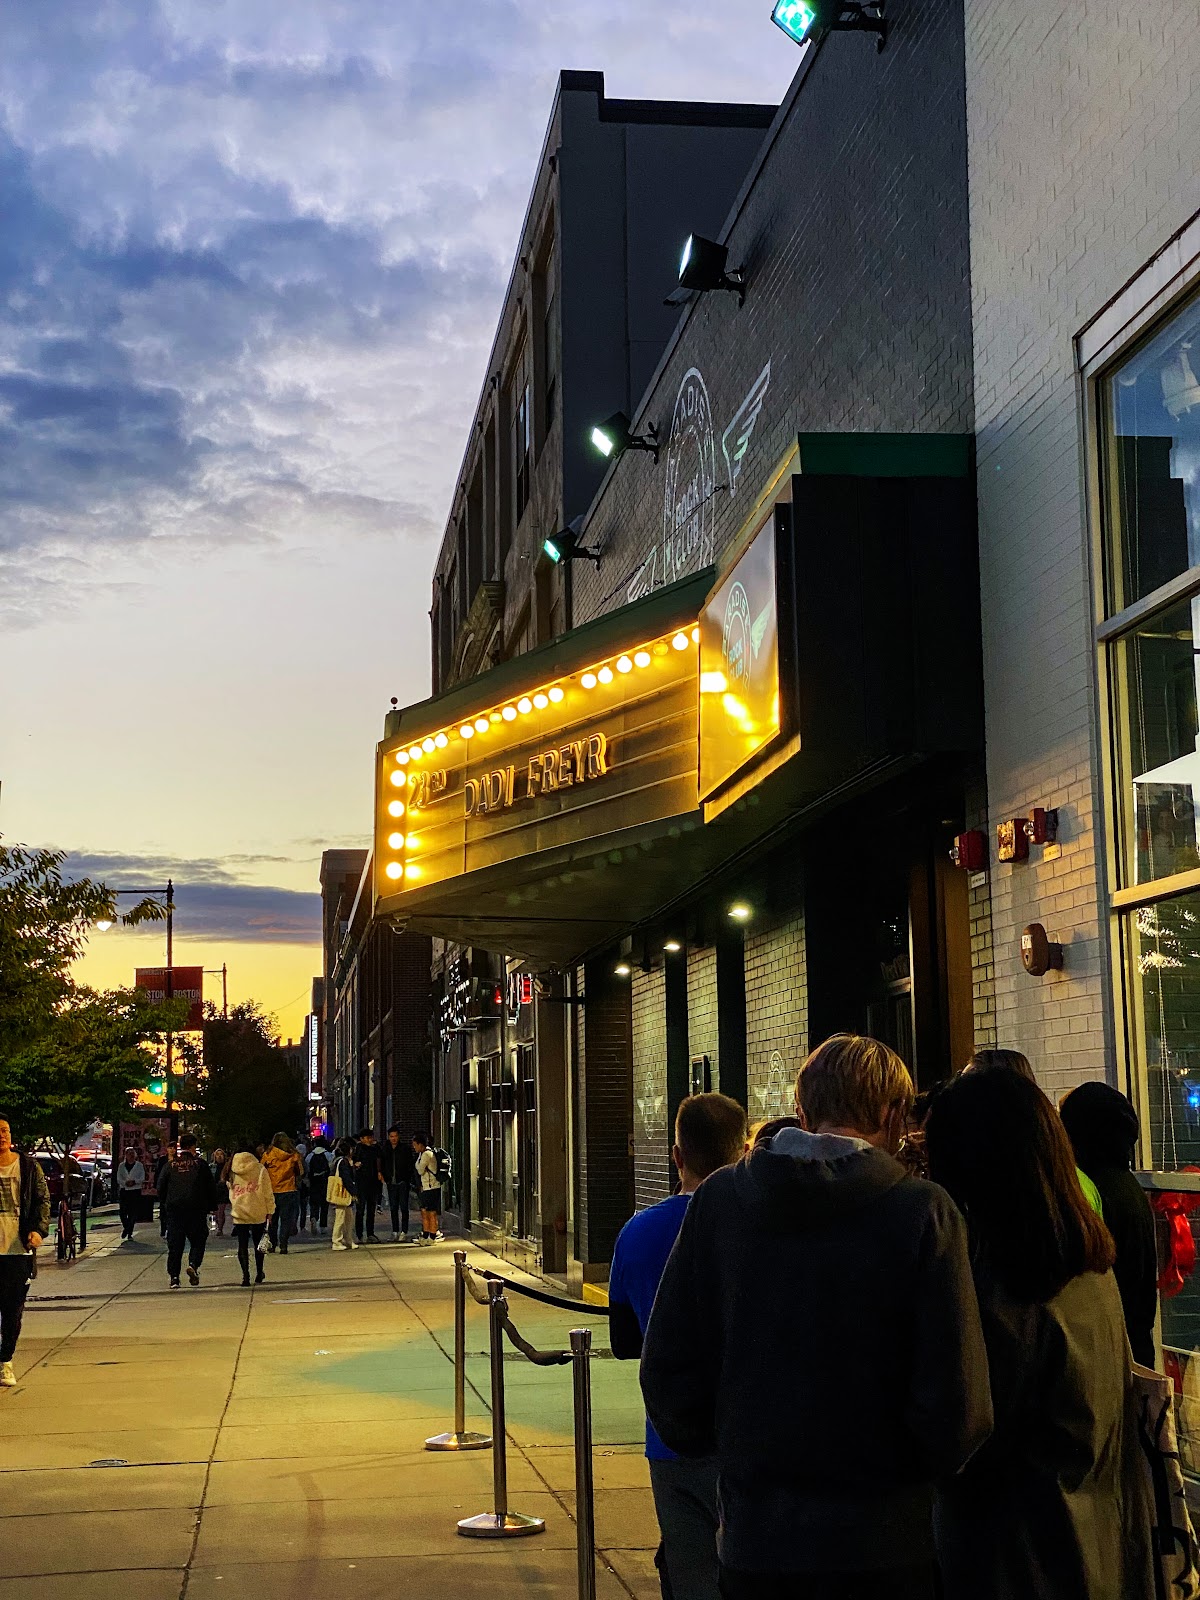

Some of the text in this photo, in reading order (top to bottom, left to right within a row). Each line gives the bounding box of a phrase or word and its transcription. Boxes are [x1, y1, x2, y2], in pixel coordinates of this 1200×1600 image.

[675, 513, 699, 570] CLUB
[464, 765, 515, 820] DADI
[526, 732, 608, 799] FREYR
[173, 989, 201, 999] BOSTON
